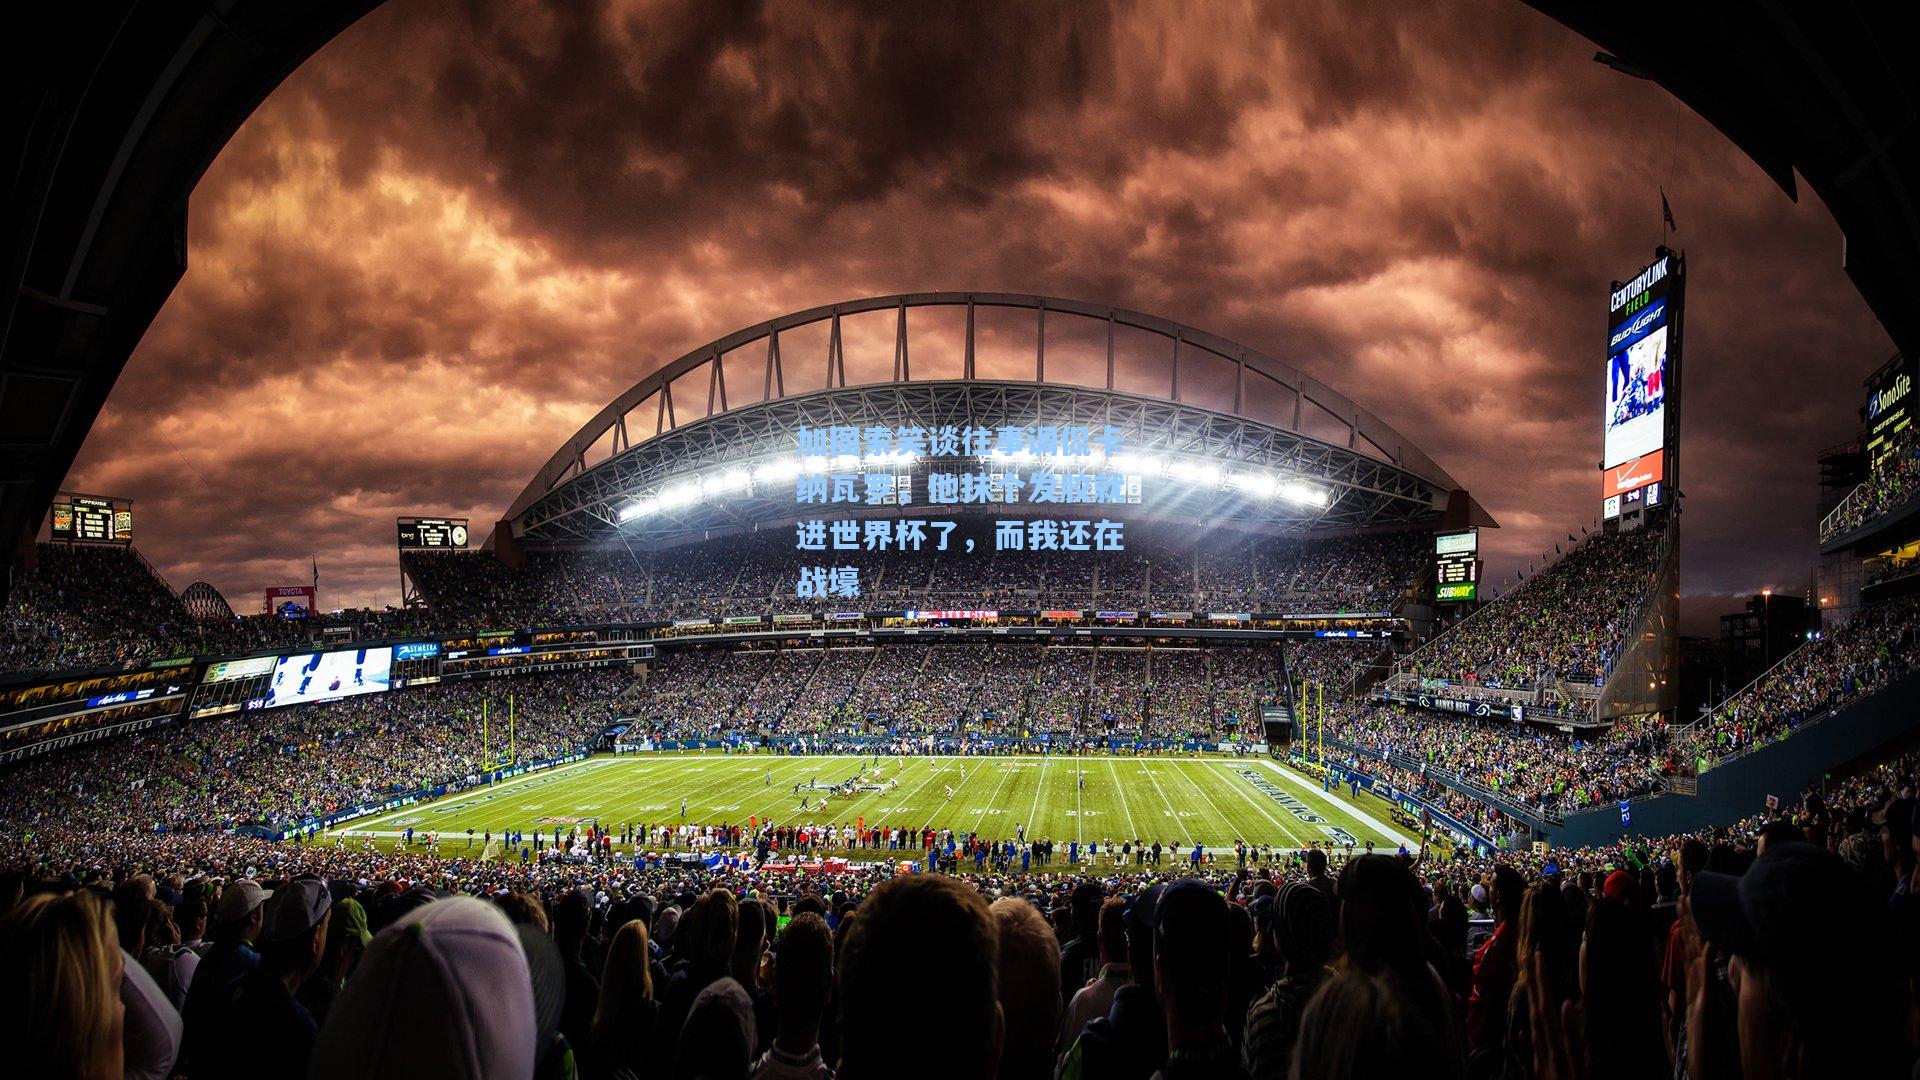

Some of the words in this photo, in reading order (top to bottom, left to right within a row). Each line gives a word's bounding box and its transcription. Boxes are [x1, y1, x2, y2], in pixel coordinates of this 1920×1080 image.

[1610, 256, 1669, 313] CENTURYLINK
[1625, 290, 1650, 316] FIELD
[1610, 326, 1633, 347] BUD
[1634, 305, 1665, 331] LIGHT
[1878, 373, 1911, 414] SonoSite
[1873, 407, 1905, 434] DEFENSE
[1437, 584, 1475, 599] SUBWAY
[409, 643, 437, 653] SYMETRA
[490, 668, 516, 677] HOME
[561, 662, 583, 670] 12TH
[9, 749, 24, 762] TO
[30, 729, 112, 756] CENTURYLINK
[117, 720, 153, 735] FIELD
[1234, 769, 1329, 823] SEAHAWKS
